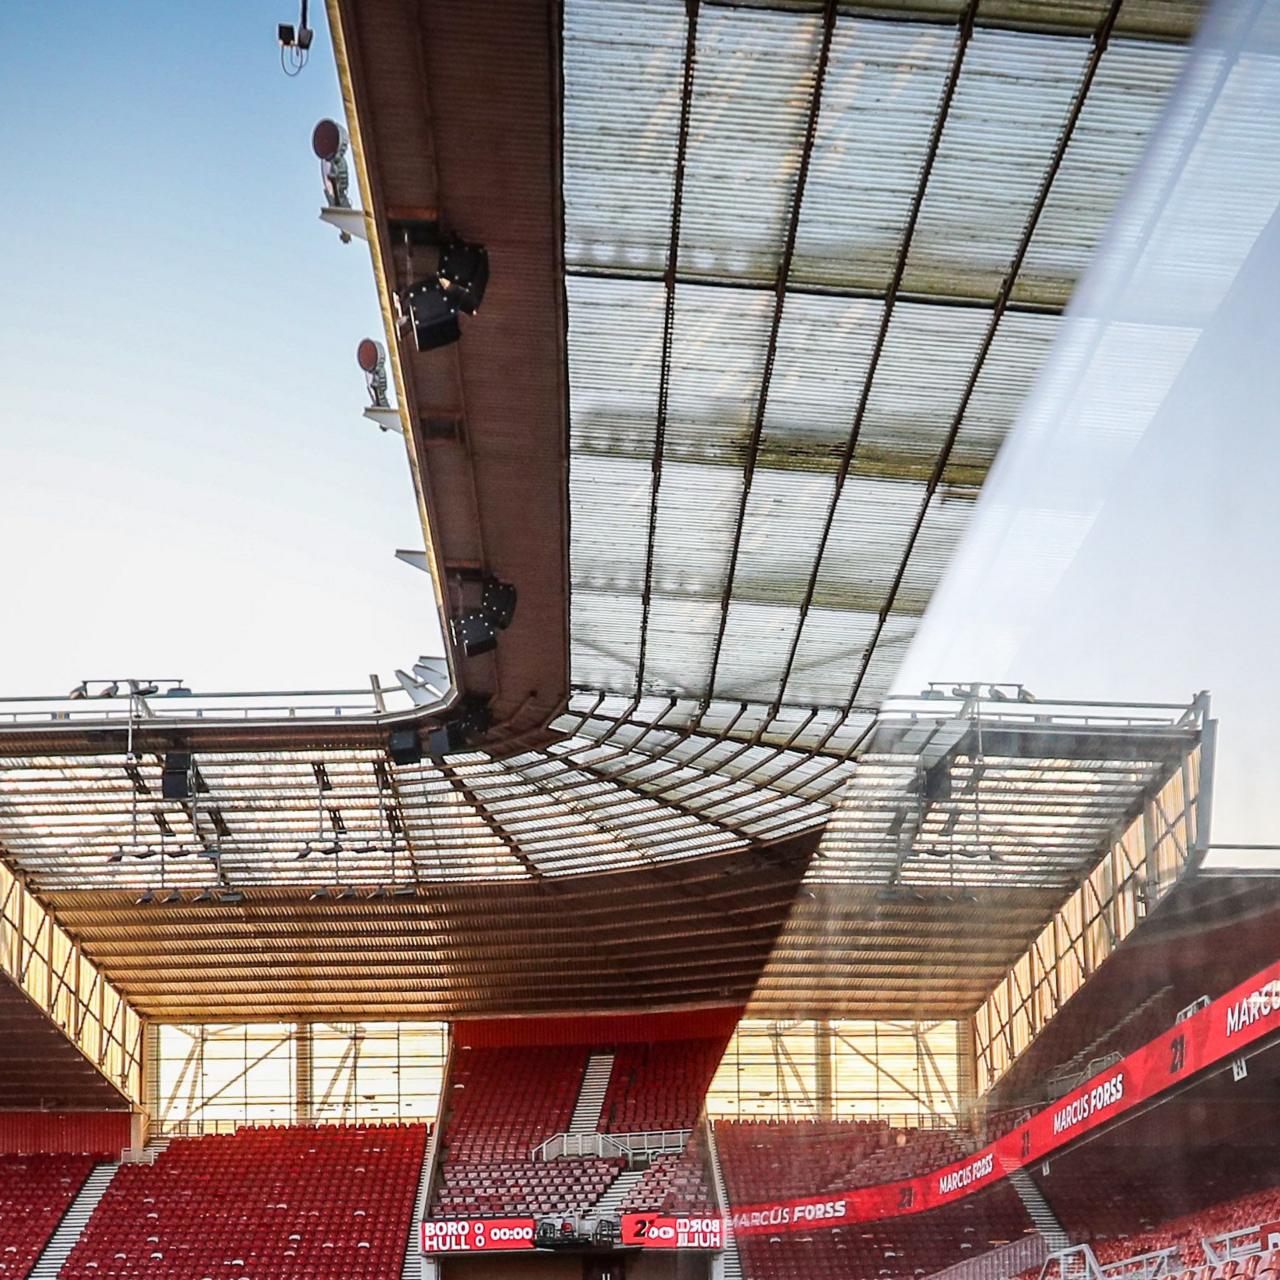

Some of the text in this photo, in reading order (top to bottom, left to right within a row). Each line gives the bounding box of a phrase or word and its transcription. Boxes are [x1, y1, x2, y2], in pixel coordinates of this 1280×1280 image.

[1053, 1073, 1124, 1136] MARCUS FORSS
[939, 1167, 971, 1195] MARCUS
[793, 1200, 847, 1222] FORSS
[425, 1222, 469, 1236] BORO
[490, 1227, 533, 1240] 00:00
[425, 1235, 470, 1250] HULL
